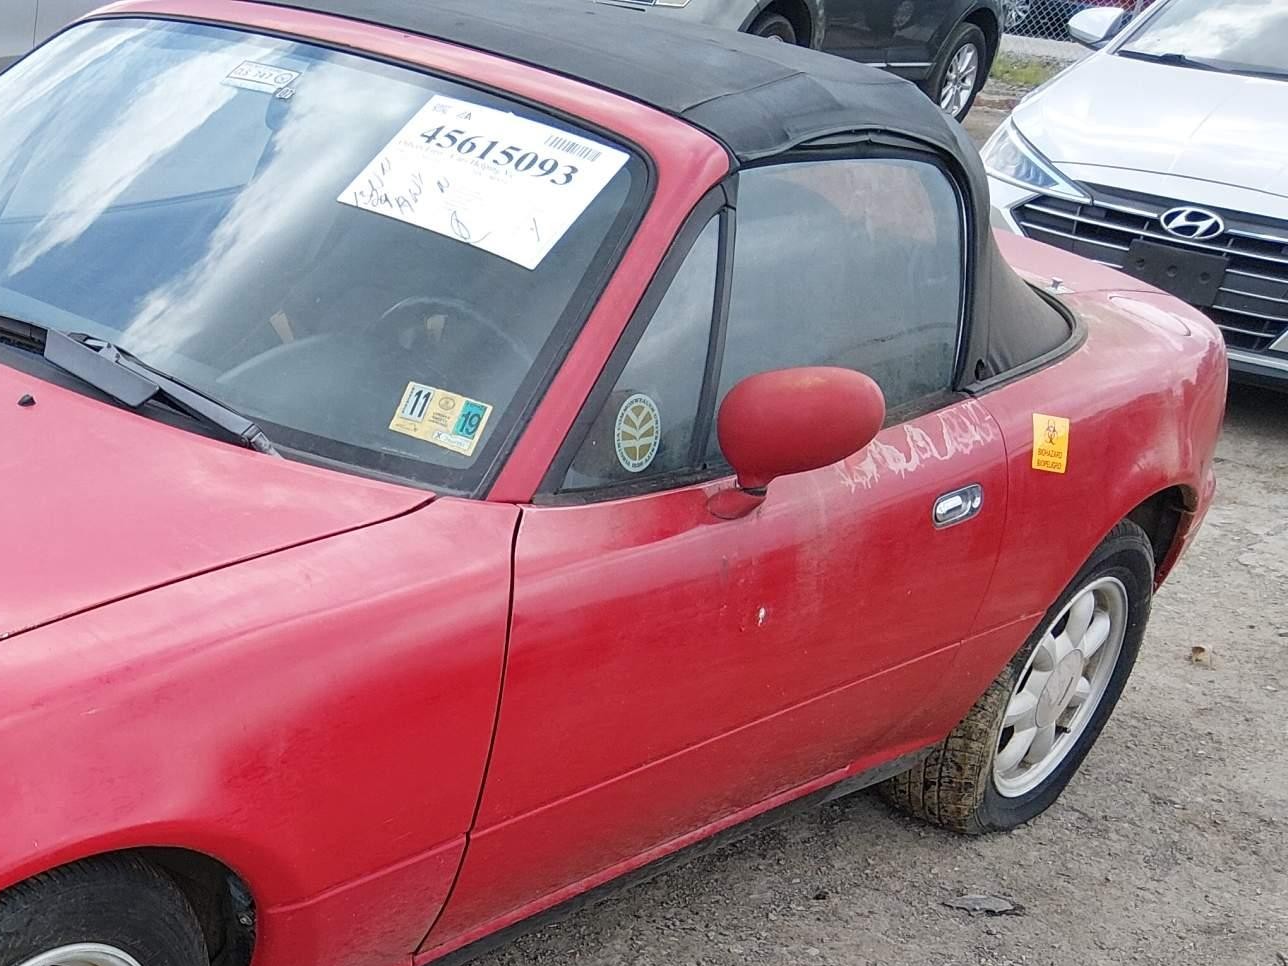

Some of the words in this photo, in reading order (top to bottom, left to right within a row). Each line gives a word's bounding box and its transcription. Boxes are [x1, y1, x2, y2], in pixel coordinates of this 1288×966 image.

[420, 125, 580, 186] 45615093
[409, 389, 431, 418] 11
[459, 410, 483, 435] 19
